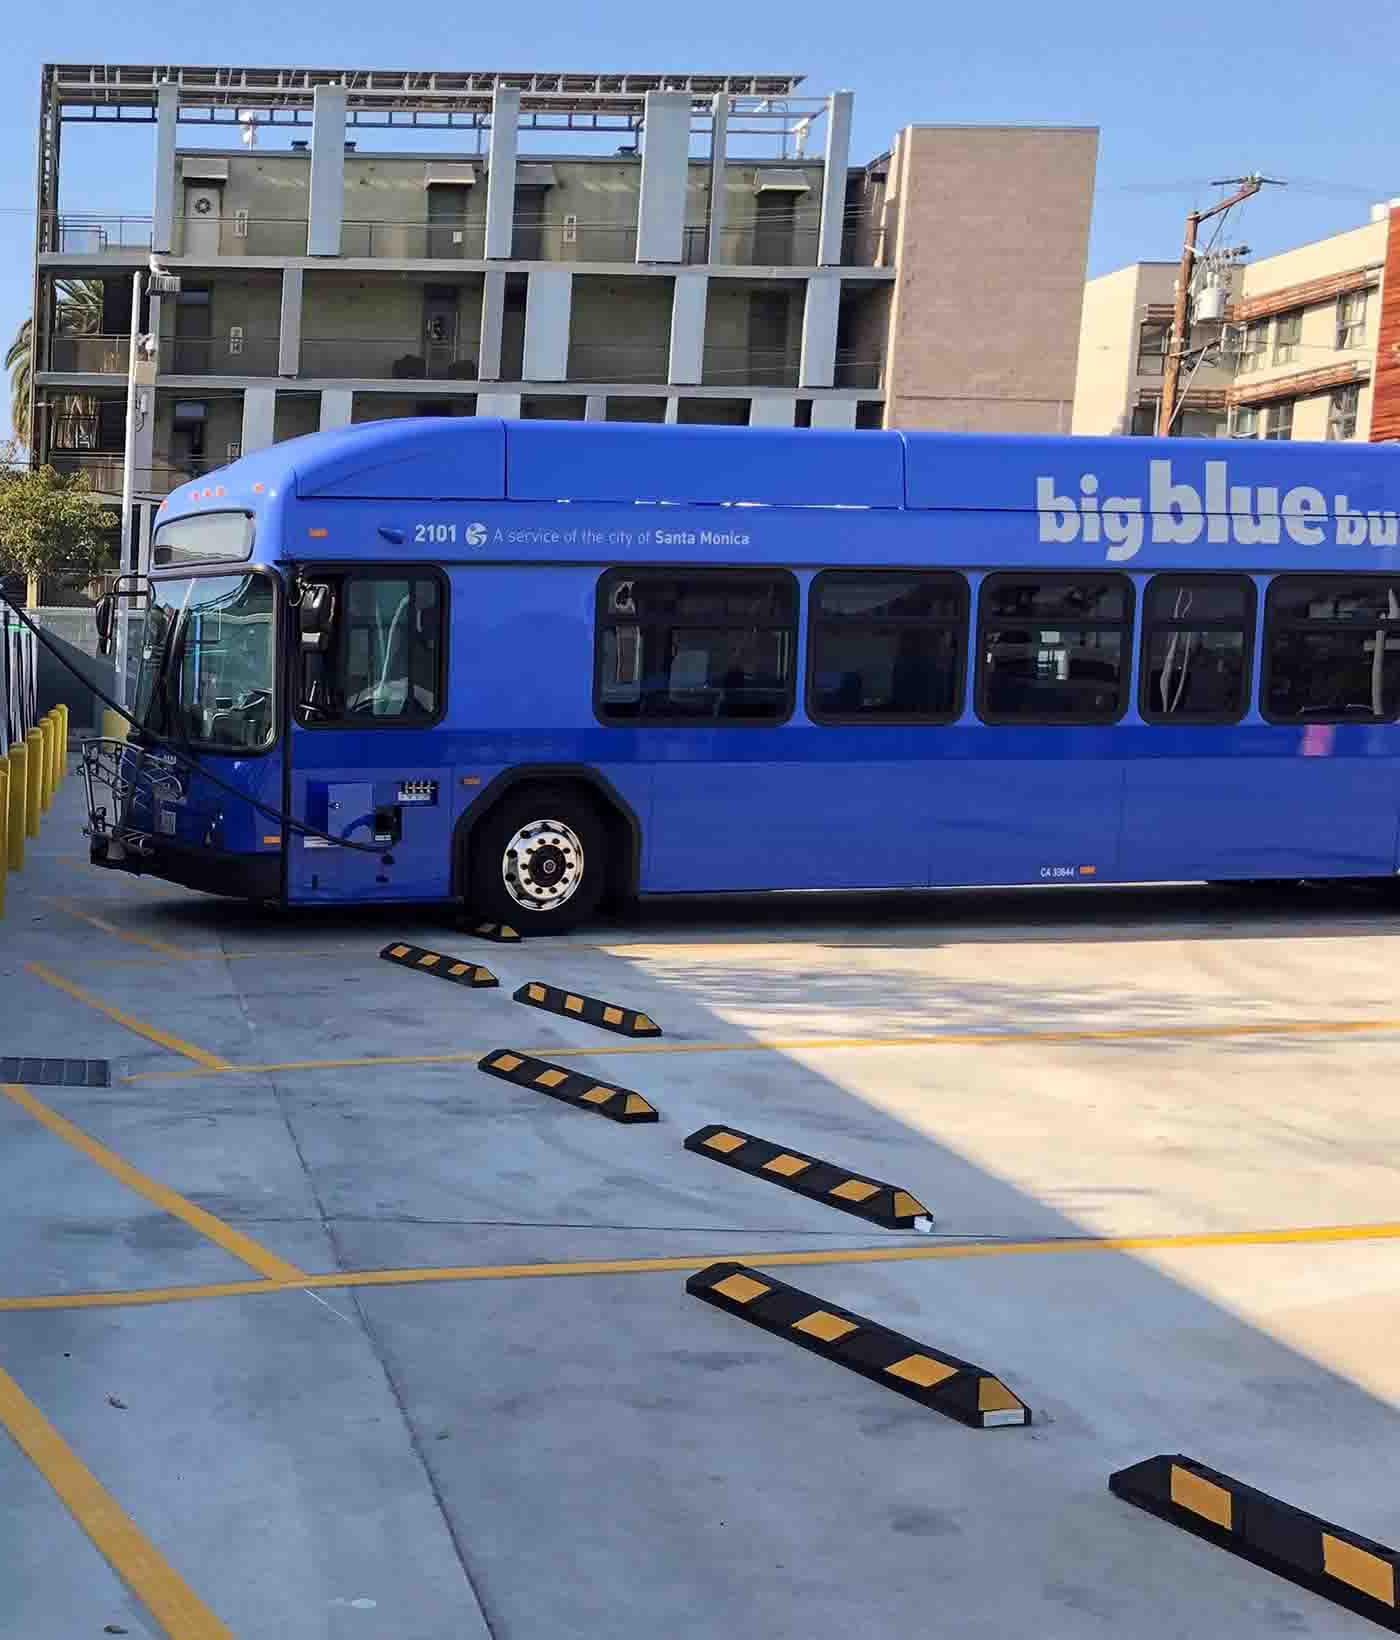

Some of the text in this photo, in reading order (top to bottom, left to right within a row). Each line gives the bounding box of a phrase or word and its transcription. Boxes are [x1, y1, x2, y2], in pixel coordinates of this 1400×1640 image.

[1036, 458, 1400, 561] big blue bu
[414, 523, 457, 543] 2101
[493, 528, 750, 549] A service of the city of Santa Monica
[1040, 866, 1051, 878] CA
